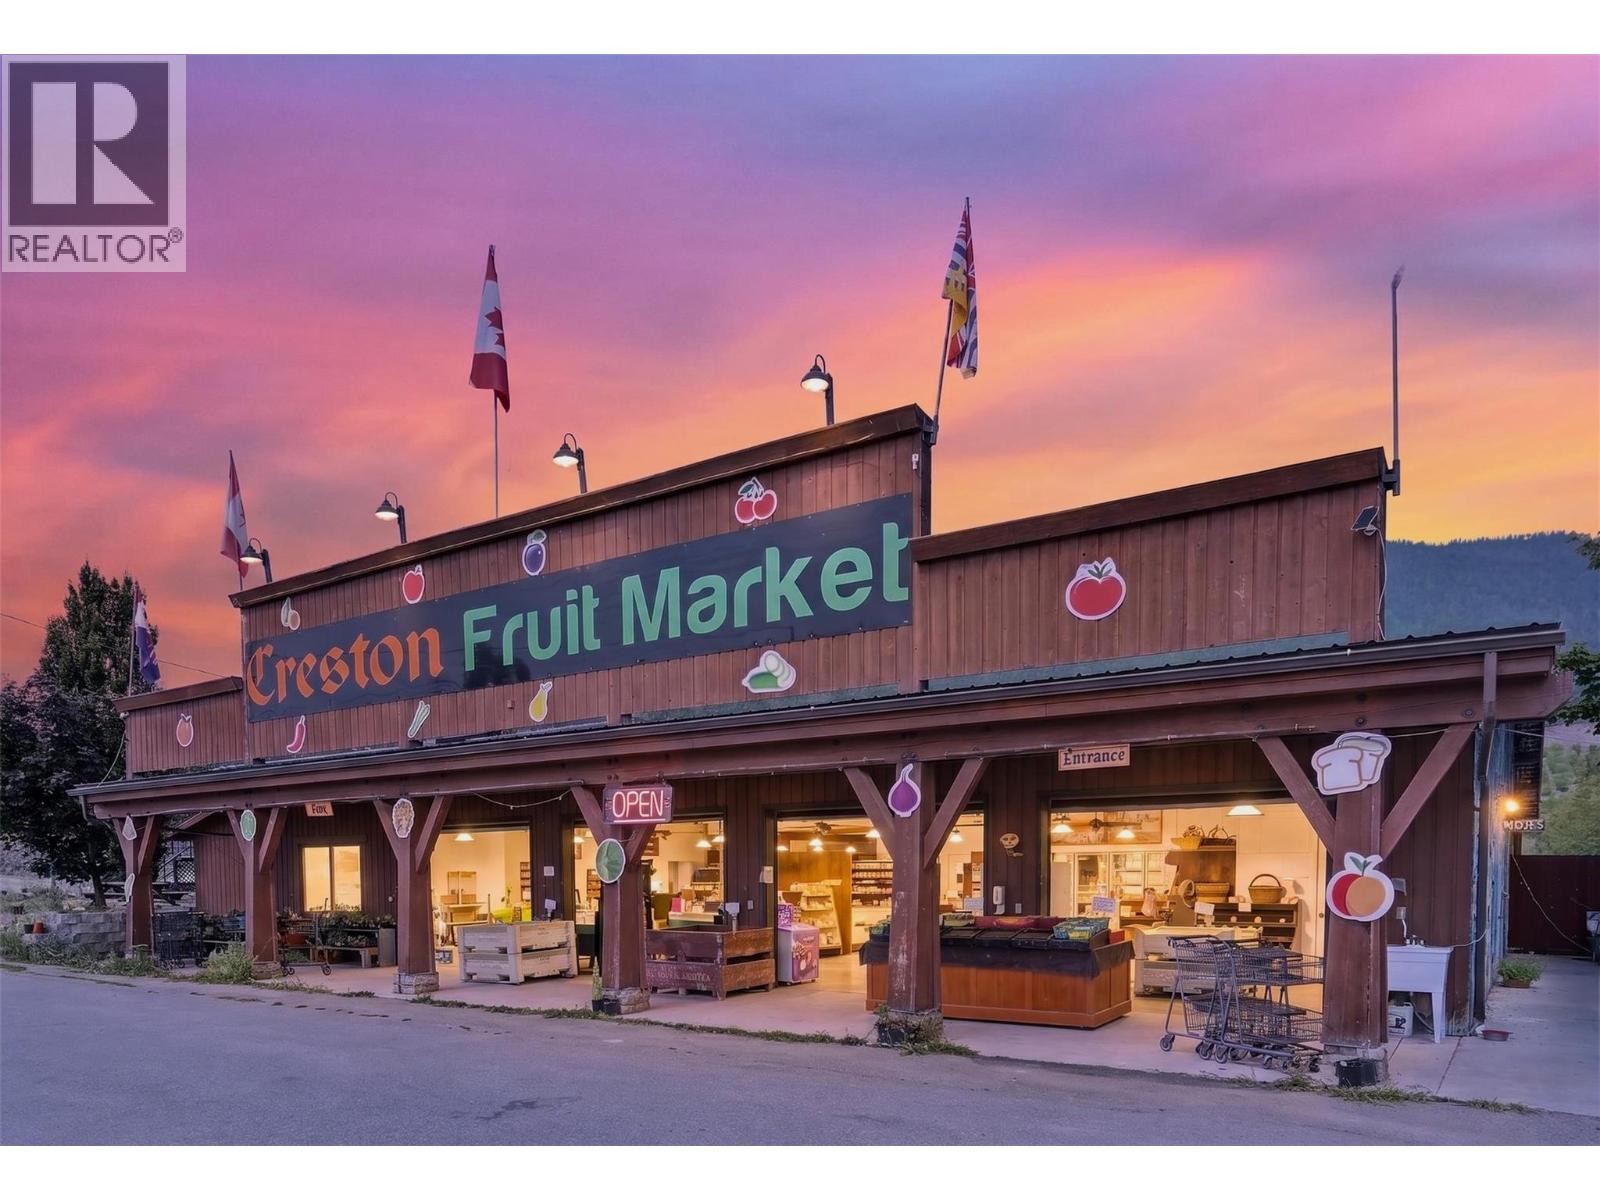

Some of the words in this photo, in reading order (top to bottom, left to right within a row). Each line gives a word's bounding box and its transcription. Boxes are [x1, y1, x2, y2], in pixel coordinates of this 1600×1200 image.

[247, 628, 444, 705] Creston
[463, 584, 601, 672] Fruit
[621, 522, 909, 647] Market
[1063, 750, 1125, 766] Entrance
[612, 790, 663, 818] OPEN
